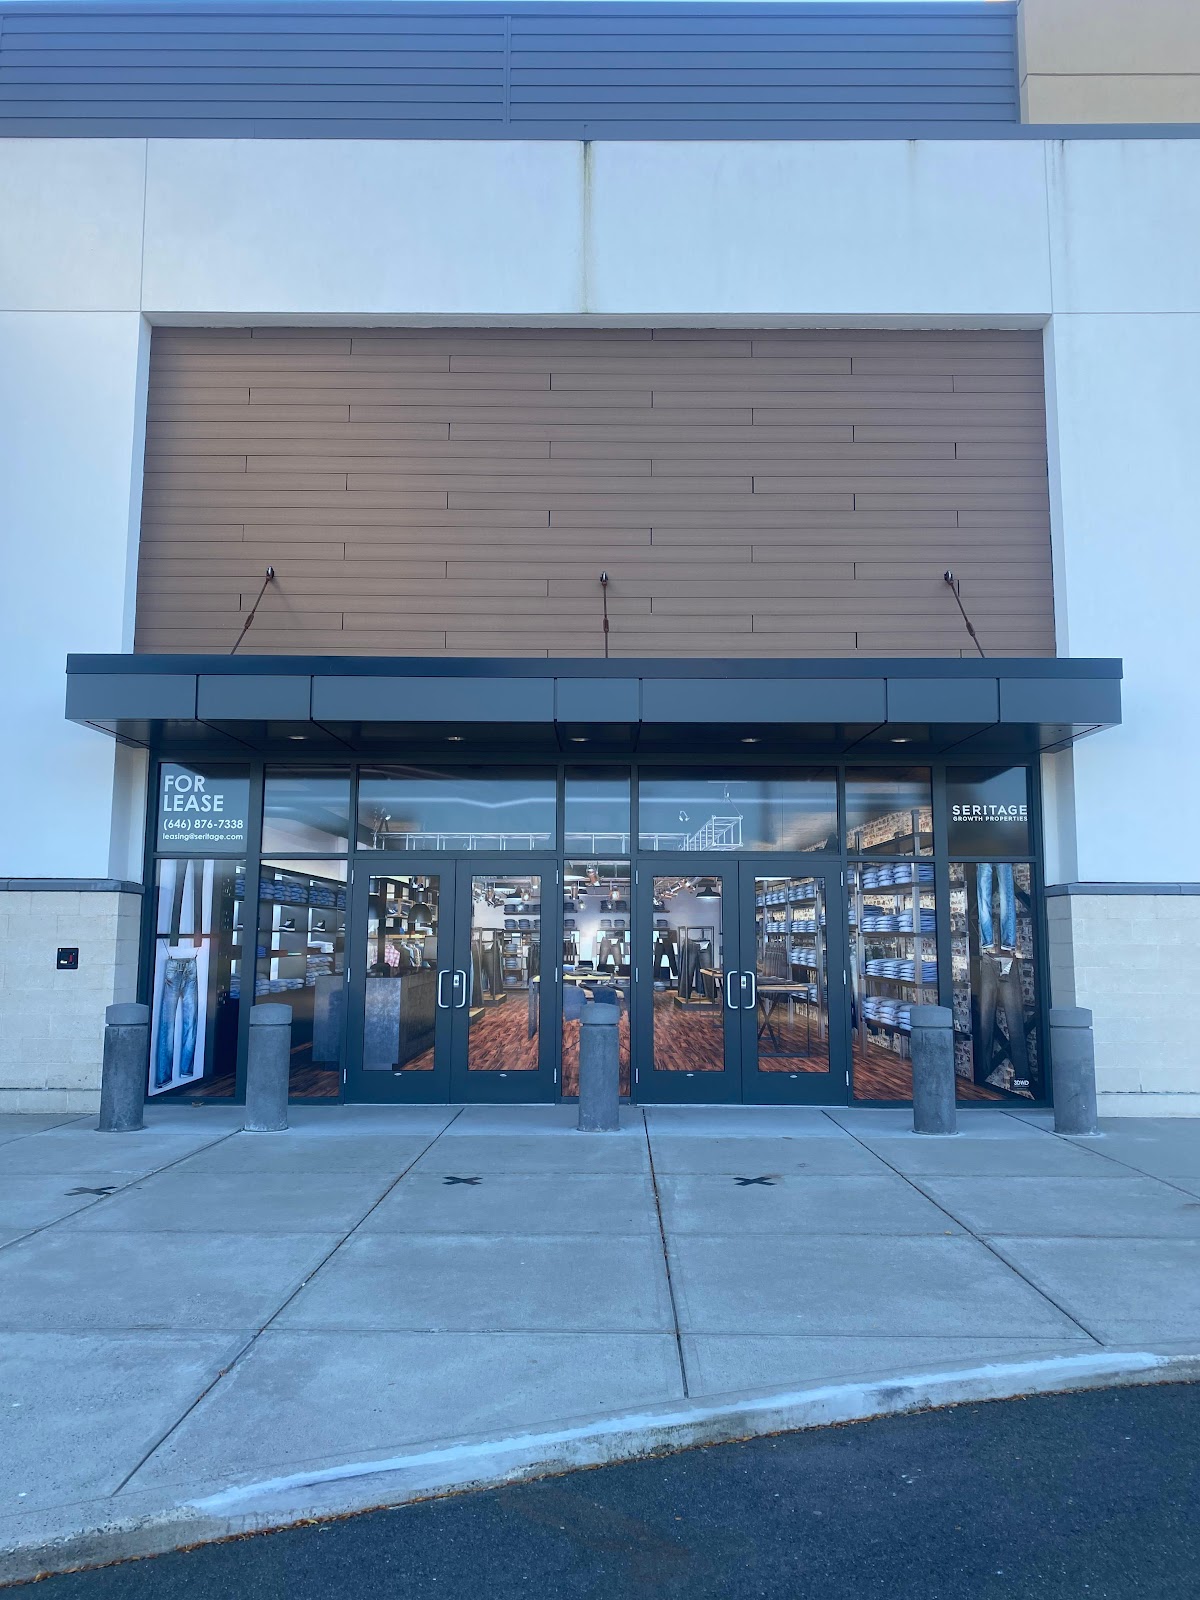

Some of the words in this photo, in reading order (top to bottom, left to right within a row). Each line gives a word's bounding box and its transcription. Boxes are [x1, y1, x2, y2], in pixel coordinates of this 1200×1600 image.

[164, 775, 205, 792] FOR
[163, 795, 224, 812] LEASE
[952, 804, 1028, 815] SERITAGE
[163, 819, 191, 830] (646)
[194, 819, 244, 829] 876-7338
[162, 832, 243, 841] leasing@seritage.com
